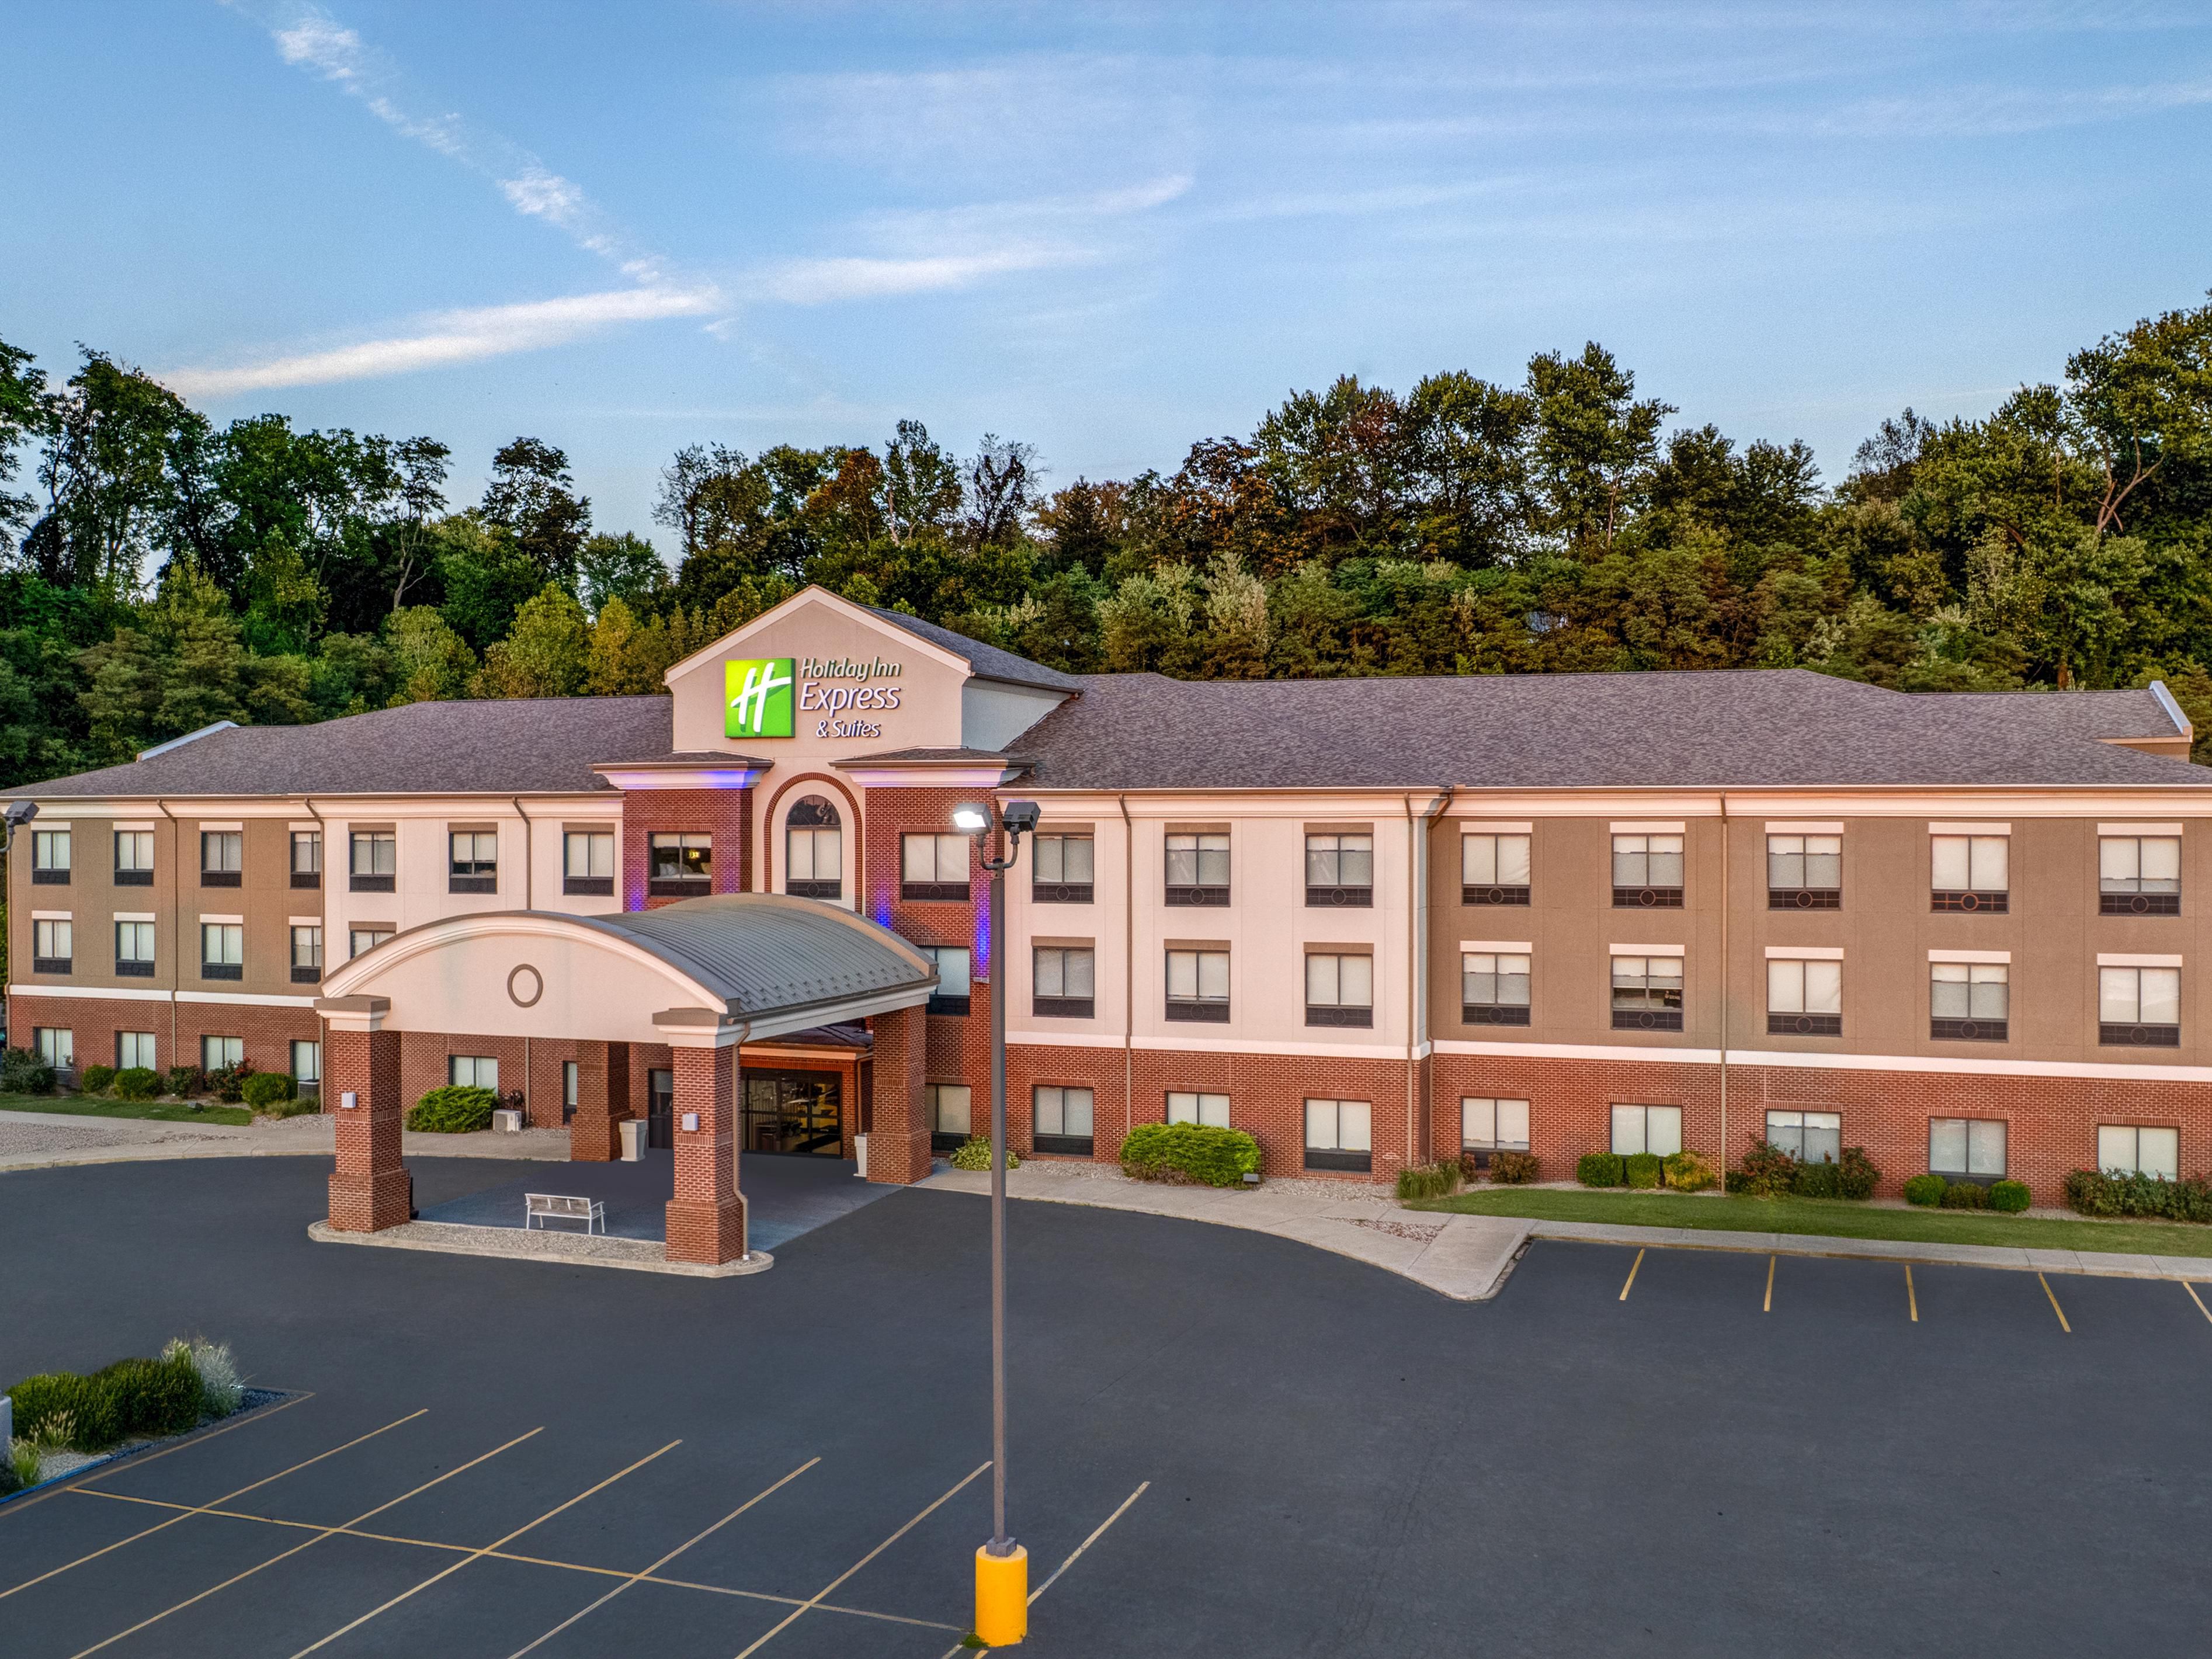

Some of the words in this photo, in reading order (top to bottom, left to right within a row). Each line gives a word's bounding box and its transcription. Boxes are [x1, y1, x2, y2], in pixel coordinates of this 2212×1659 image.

[800, 658, 870, 682] Holiday
[871, 657, 901, 676] Inn
[731, 662, 791, 733] H
[800, 682, 900, 717] Express
[816, 720, 828, 738] &
[831, 720, 880, 738] Suites
